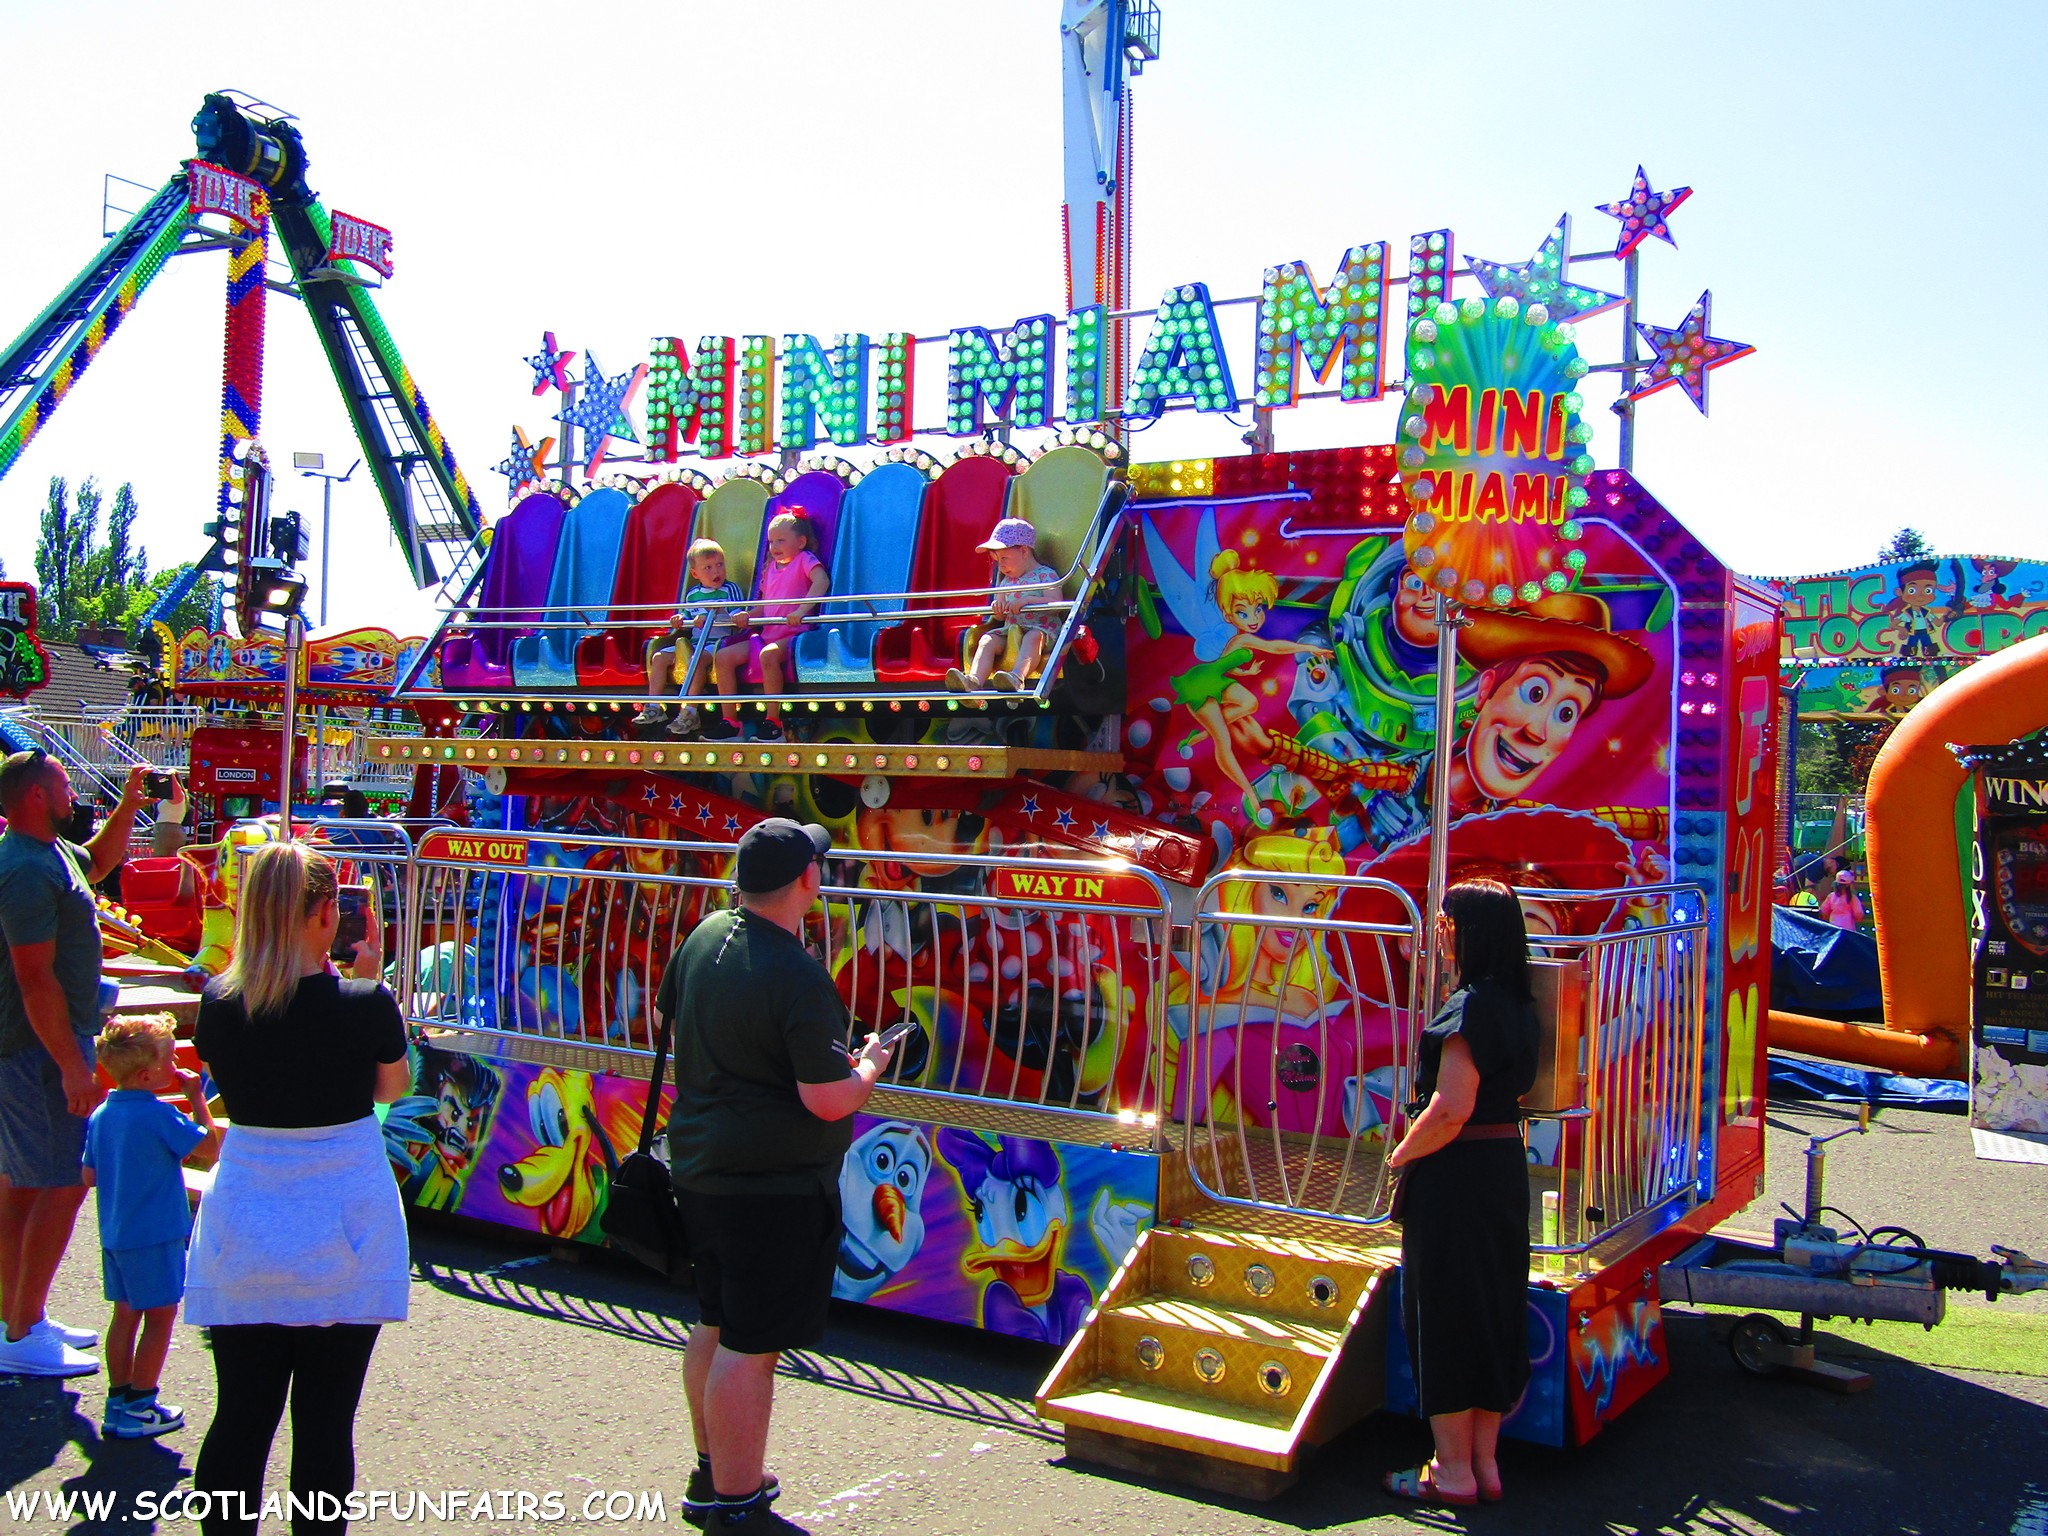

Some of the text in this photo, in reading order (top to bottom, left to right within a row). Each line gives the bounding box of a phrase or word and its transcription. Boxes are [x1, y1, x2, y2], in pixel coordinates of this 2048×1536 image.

[191, 164, 263, 230] TOXIC
[333, 213, 393, 279] TOXIC
[644, 331, 915, 463] MINI
[1418, 383, 1568, 461] MINI
[1416, 468, 1568, 526] MIAMI
[1793, 573, 1885, 618] TIC
[1783, 611, 1896, 658] TOC
[388, 723, 418, 732] TOXIC
[218, 770, 254, 779] LONDON
[447, 840, 524, 860] WAY OUT
[1011, 873, 1104, 898] WAY IN
[1724, 674, 1770, 1128] FUN
